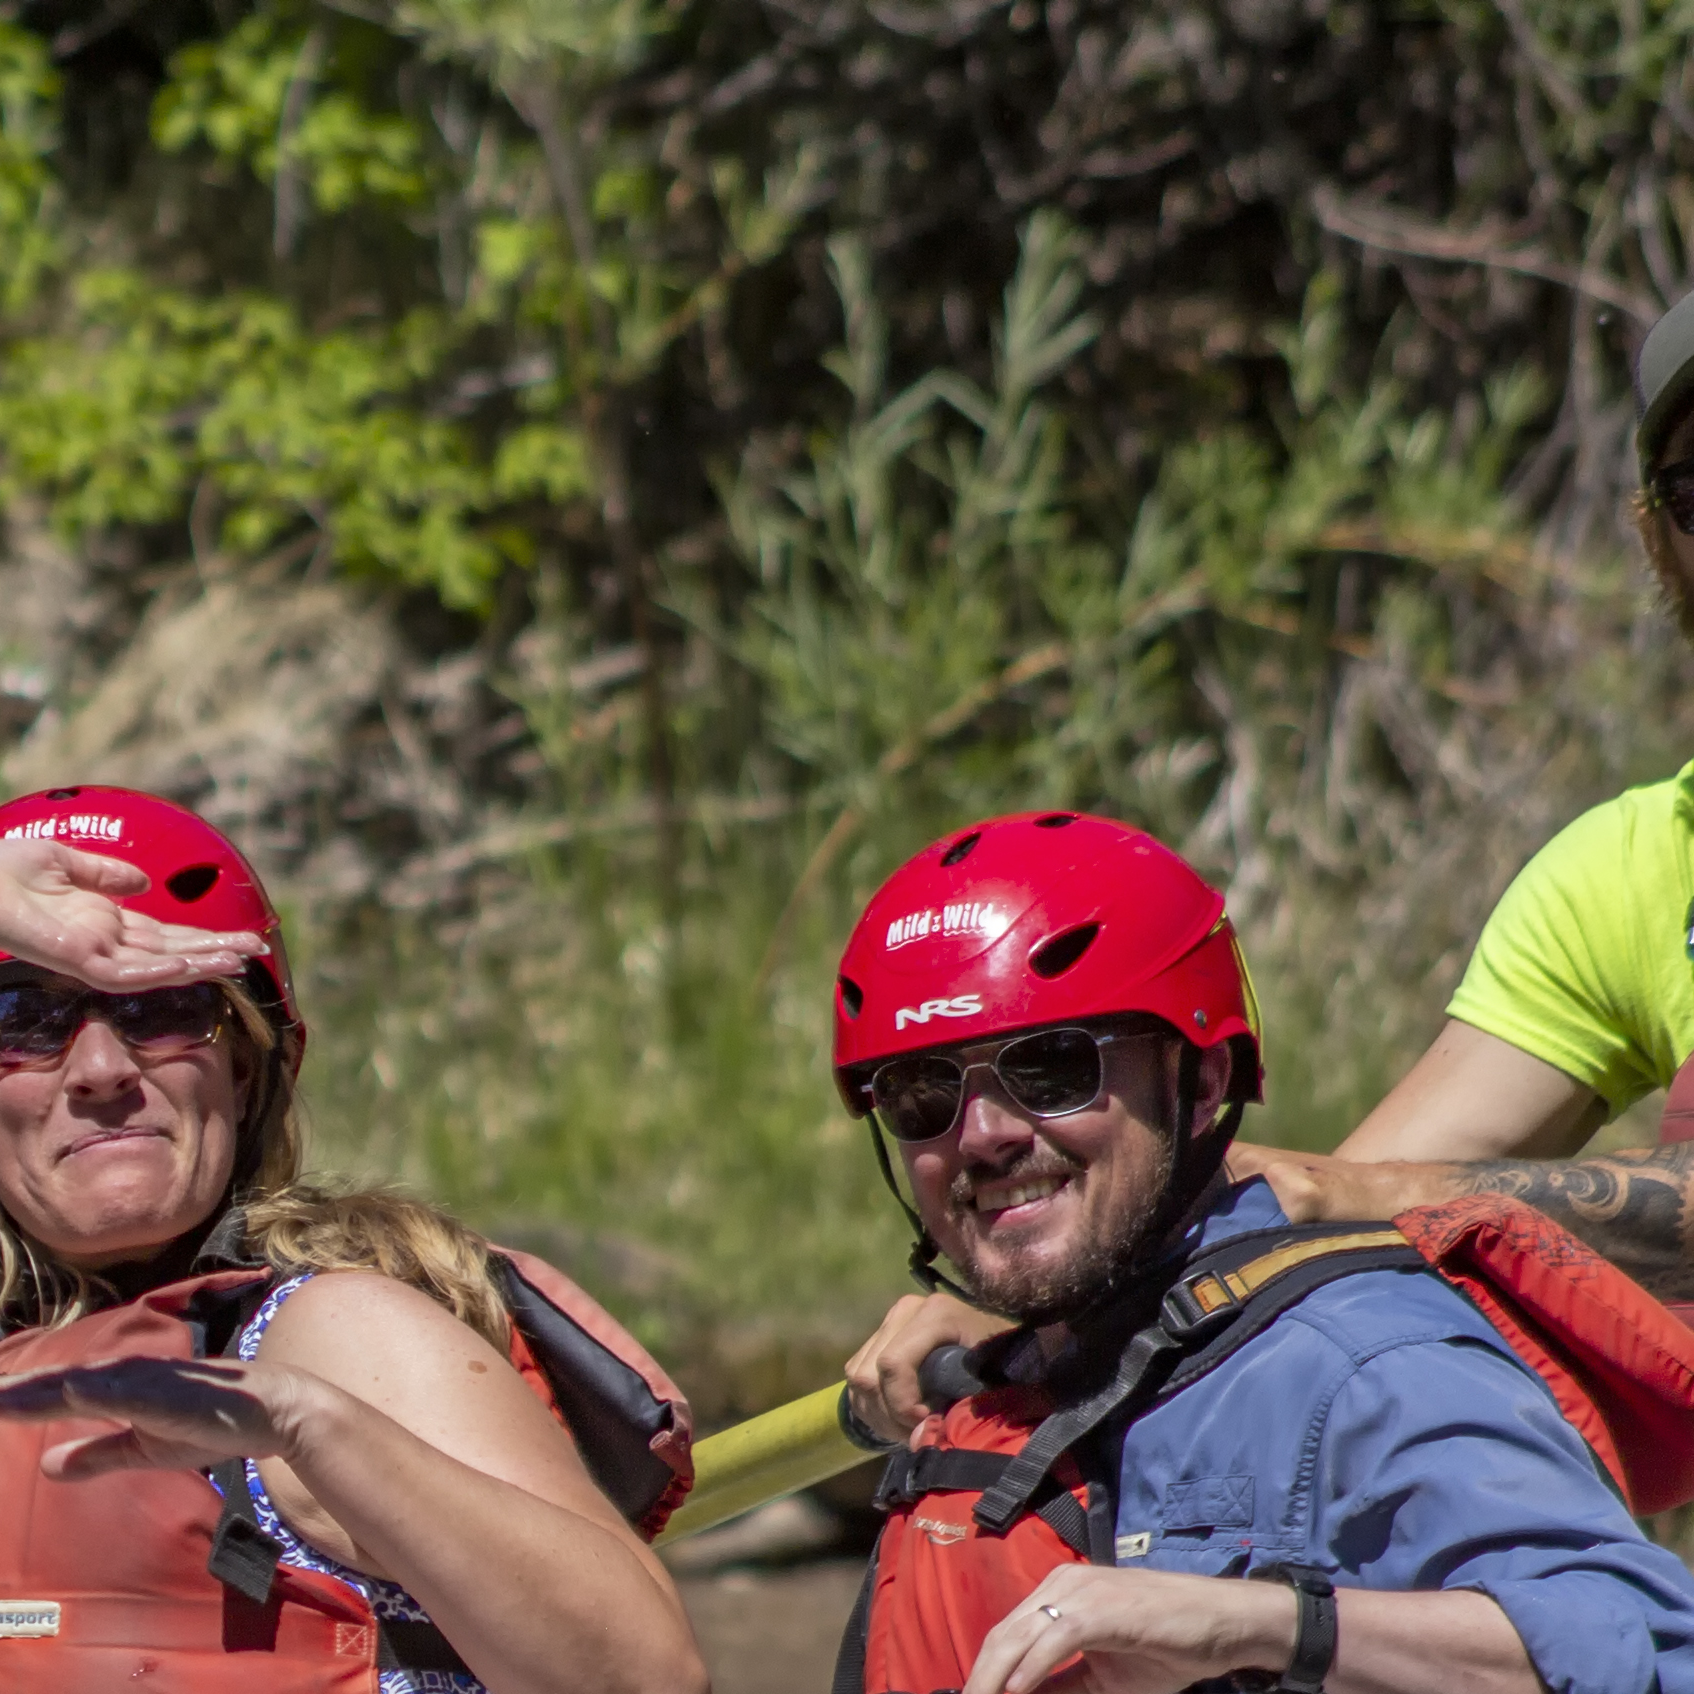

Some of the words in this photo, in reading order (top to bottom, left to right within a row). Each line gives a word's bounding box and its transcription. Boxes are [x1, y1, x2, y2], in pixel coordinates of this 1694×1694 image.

[70, 815, 122, 838] Wild
[886, 910, 931, 947] Mild
[943, 903, 993, 930] Wild
[895, 994, 983, 1031] NRS
